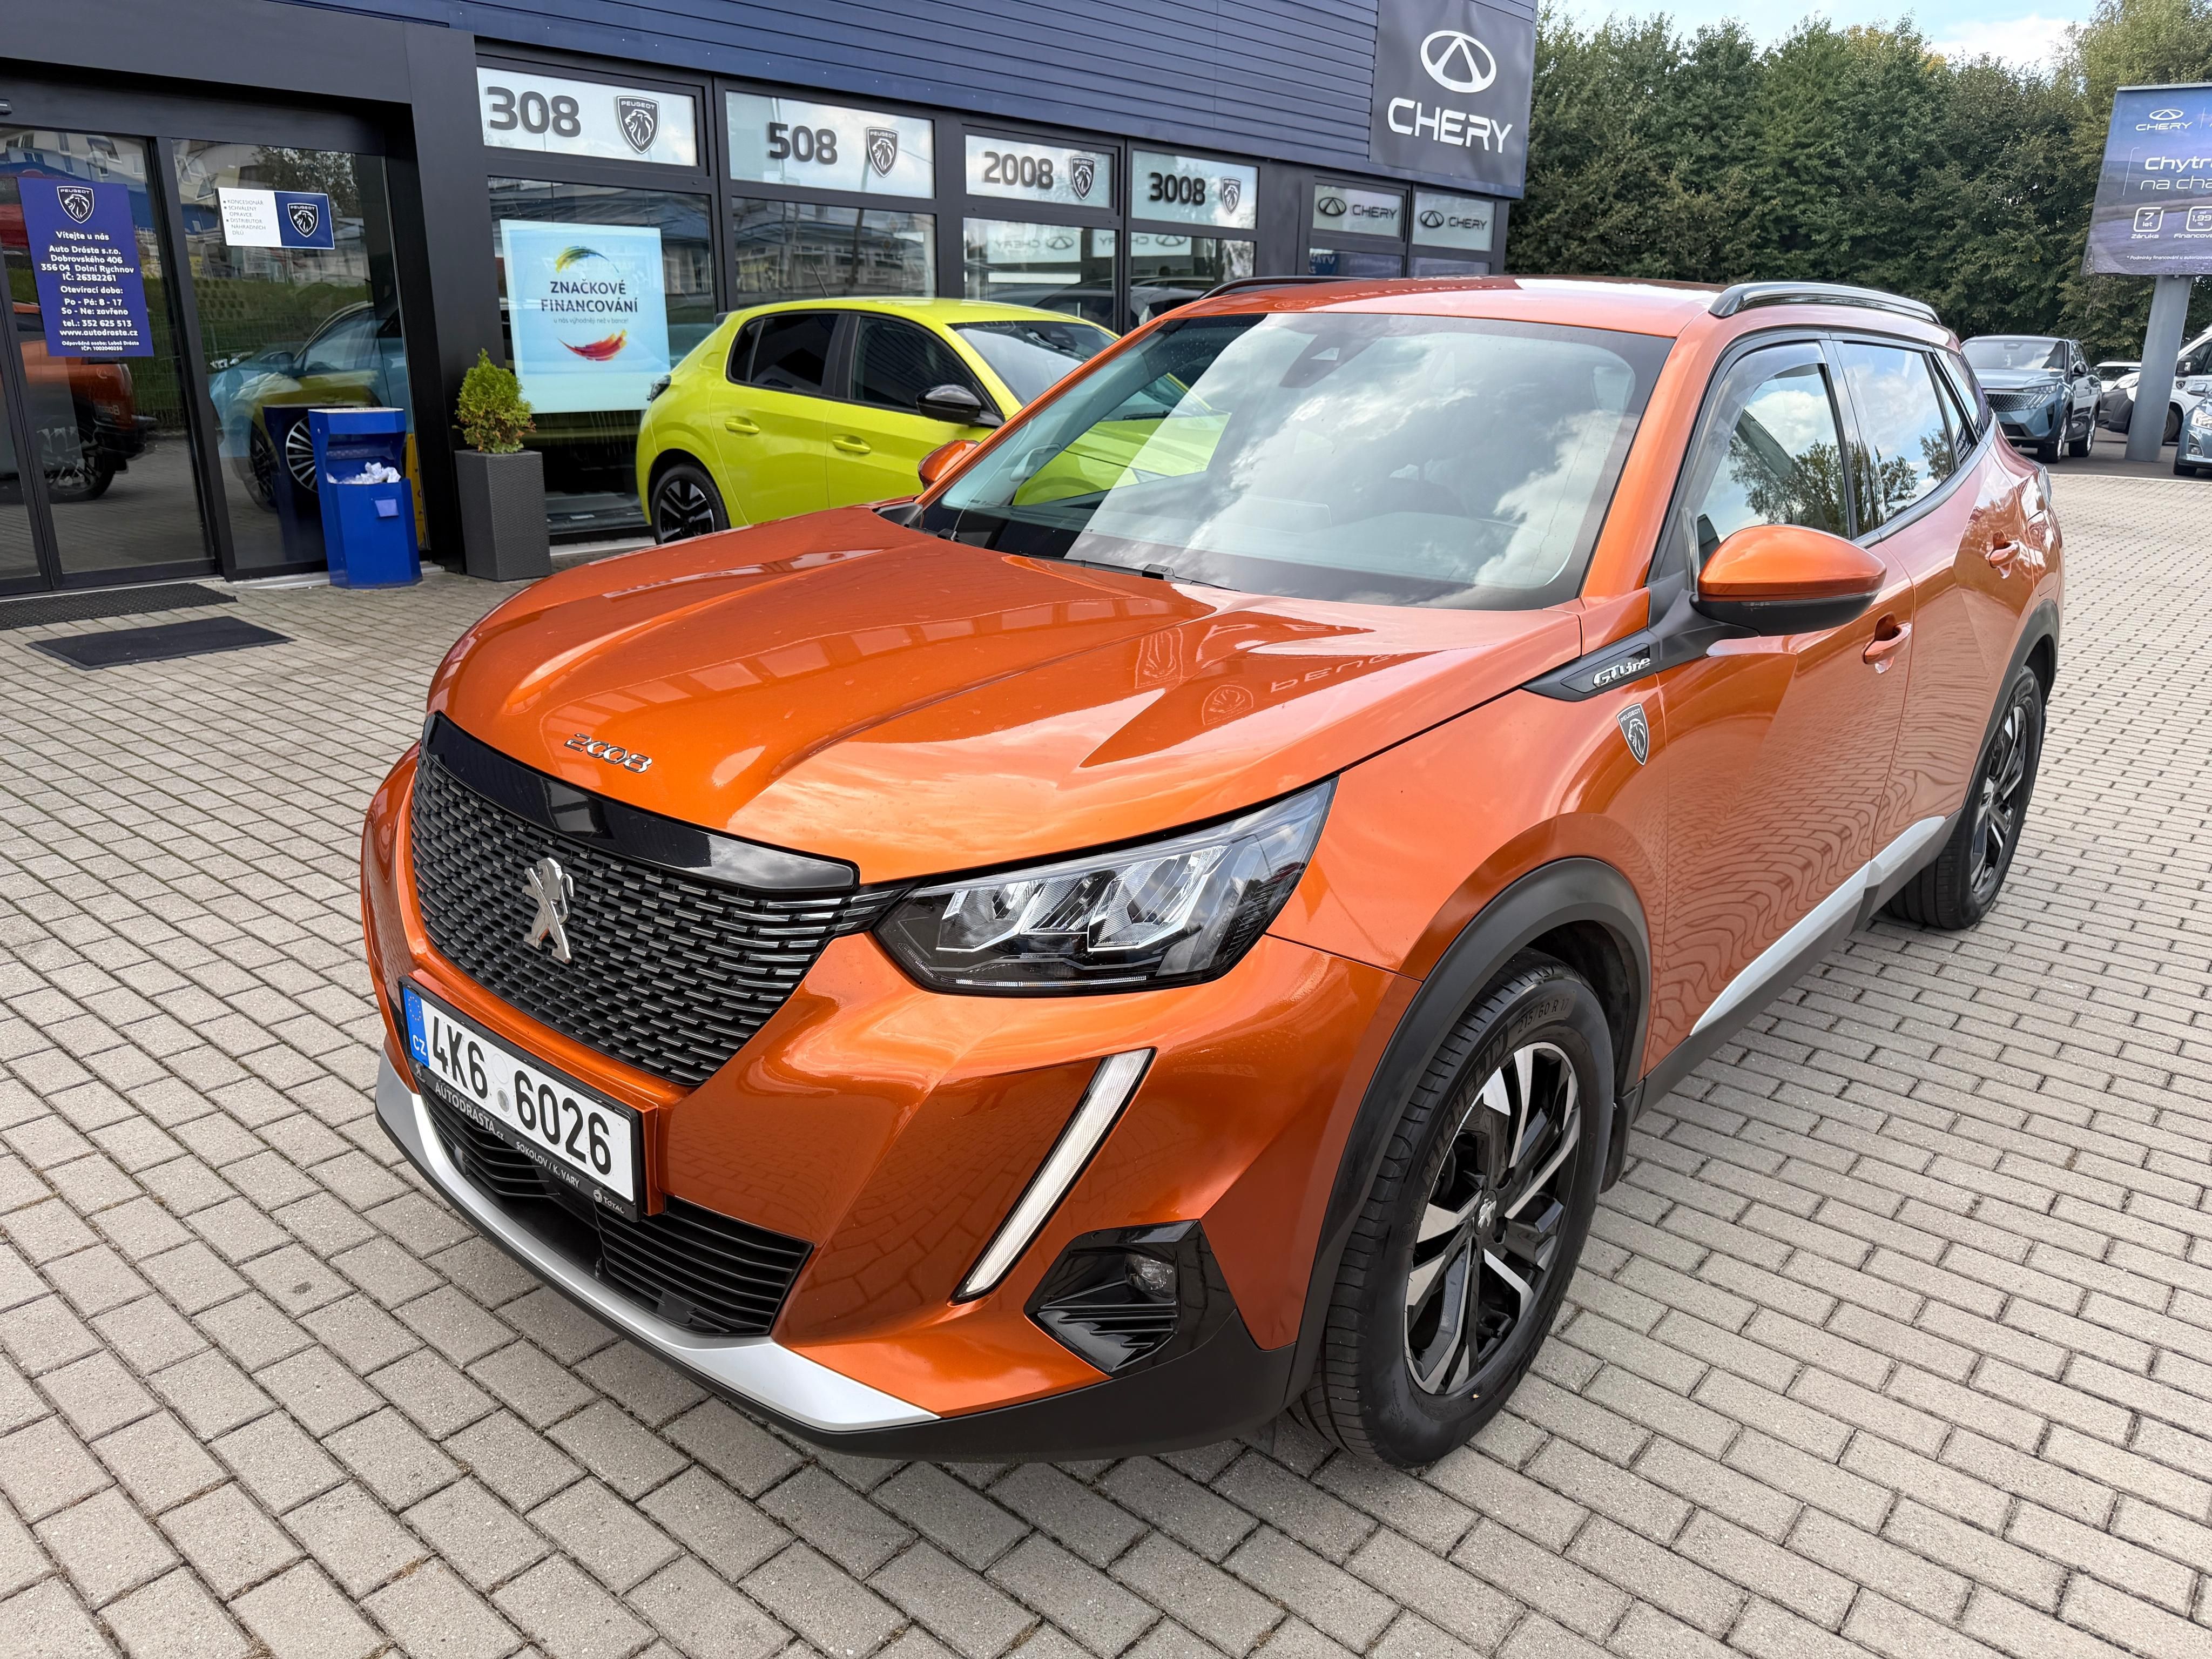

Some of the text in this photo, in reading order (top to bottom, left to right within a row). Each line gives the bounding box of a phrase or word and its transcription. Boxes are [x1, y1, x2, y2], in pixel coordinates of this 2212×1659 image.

[485, 86, 582, 138] 308
[621, 101, 656, 109] PEUGEOT
[1388, 97, 1513, 153] CHERY
[2135, 122, 2193, 131] CHERY
[869, 131, 896, 139] PEUGEOT
[769, 122, 838, 165] 508
[983, 151, 1054, 190] 2008
[2145, 156, 2212, 173] Chytr
[1149, 172, 1206, 206] 3008
[2140, 180, 2170, 190] na
[1353, 204, 1397, 220] CHERY
[2145, 212, 2154, 221] 7
[1449, 217, 1487, 230] CHERY
[56, 231, 85, 240] Vítejte
[71, 246, 99, 254] Drásta
[50, 254, 105, 263] Dobrovského
[99, 265, 134, 274] Rychnov
[60, 286, 99, 294] Otevírací
[550, 279, 626, 295] ZNAČKOVÉ
[541, 298, 638, 312] FINANCOVÁNÍ
[1620, 708, 1641, 723] PEUGEOT
[564, 733, 652, 773] 2008
[413, 1034, 427, 1057] CZ
[432, 1015, 612, 1175] 4K6 6026
[516, 1142, 549, 1167] SOKOLOV
[561, 1169, 580, 1188] VARY
[603, 1196, 625, 1214] TOTAL
